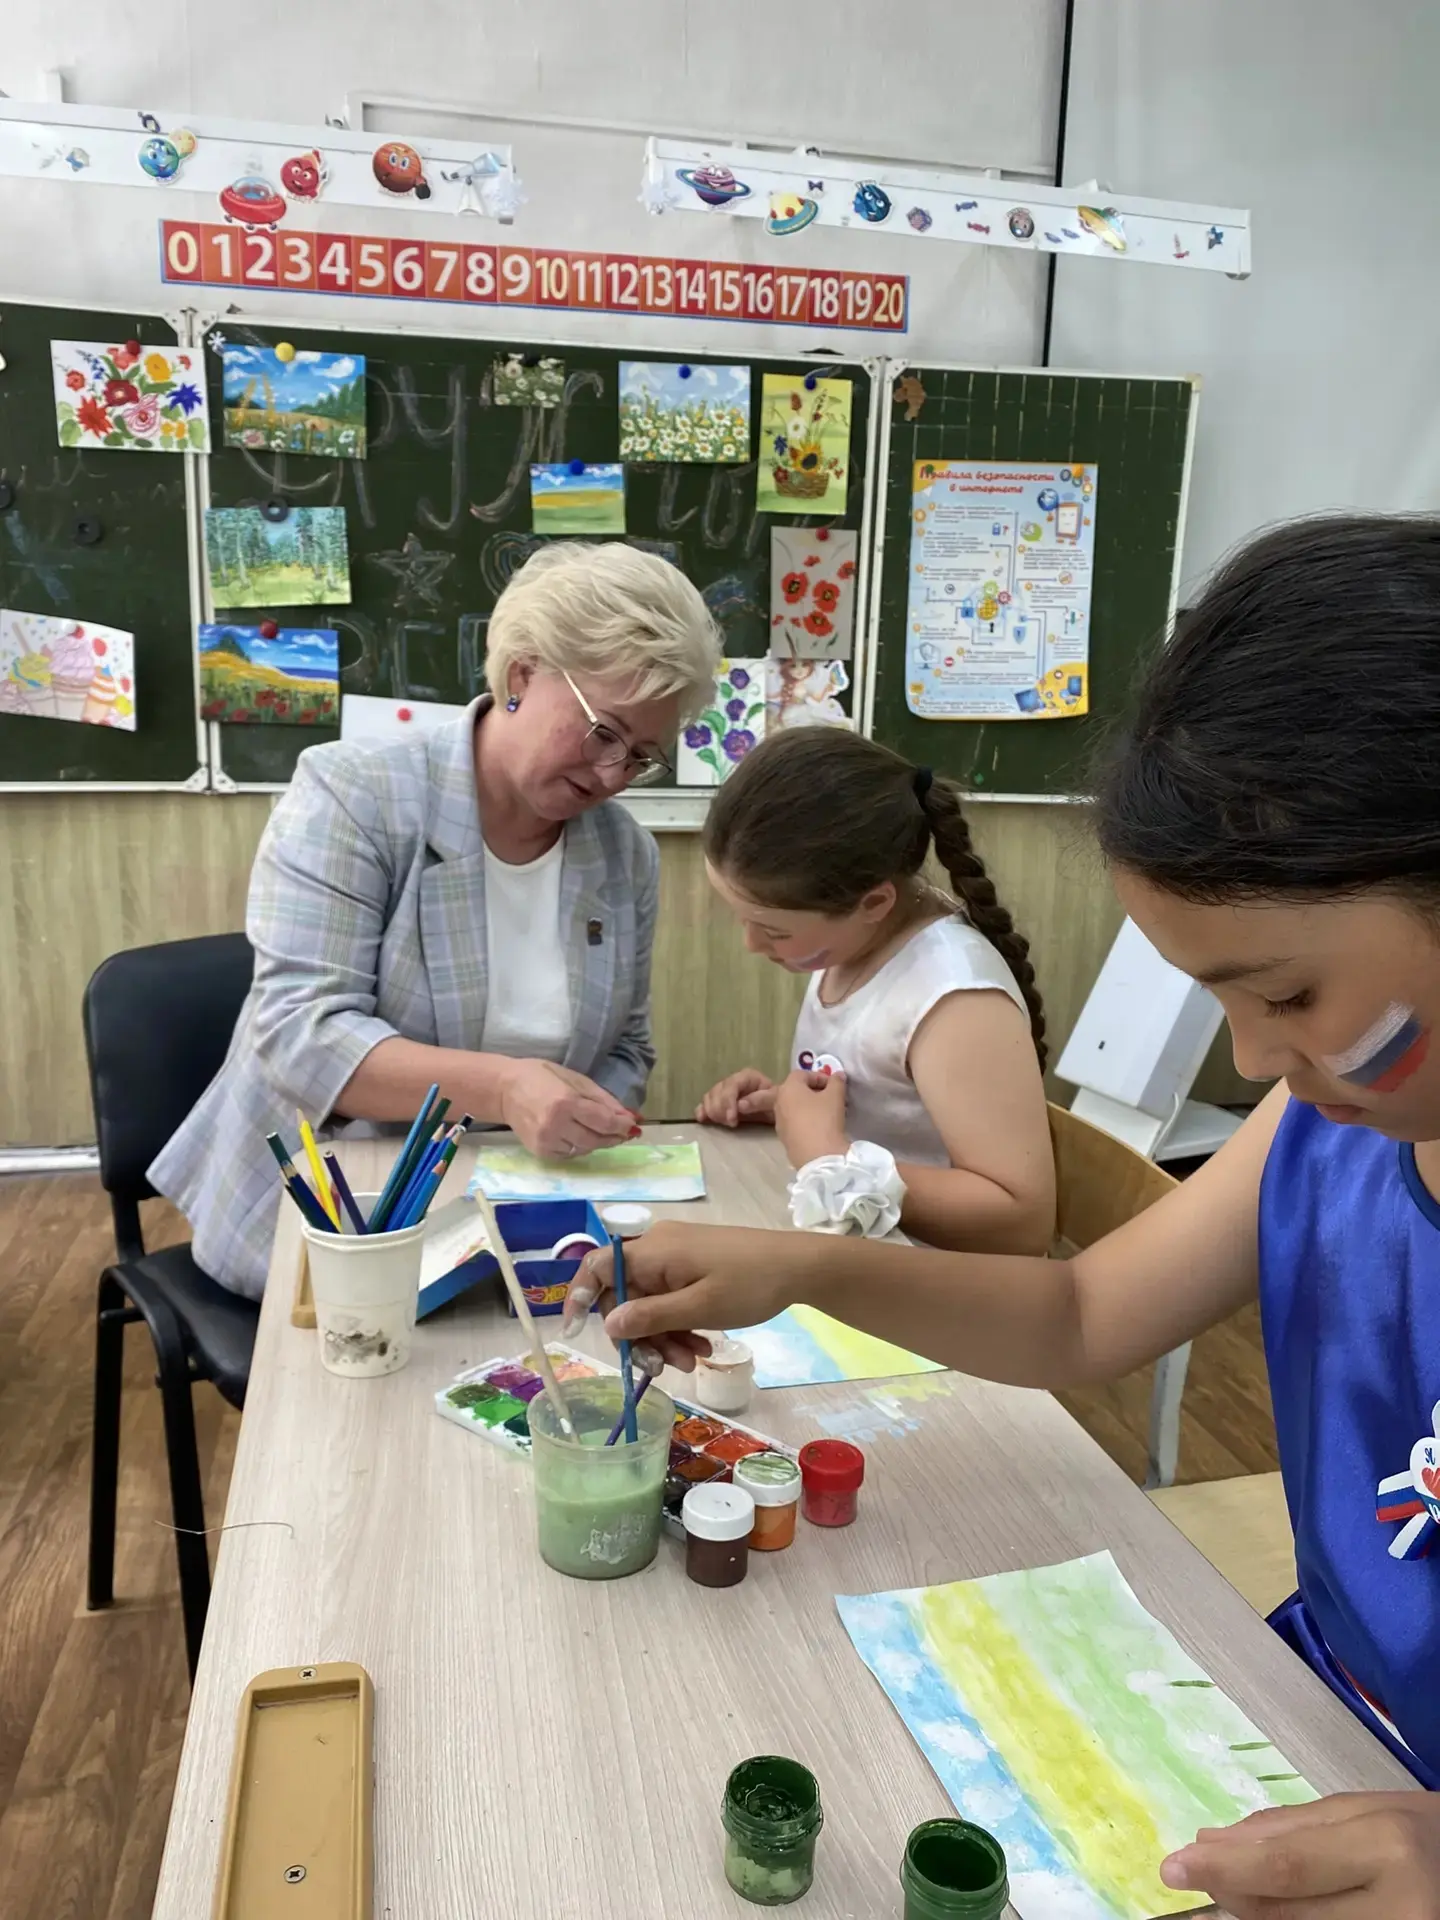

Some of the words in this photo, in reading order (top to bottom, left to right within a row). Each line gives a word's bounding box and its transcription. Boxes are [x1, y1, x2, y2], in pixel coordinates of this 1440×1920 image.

[168, 230, 198, 275] 0
[212, 233, 232, 277] 1
[245, 235, 275, 281] 2
[284, 238, 312, 283] 3
[319, 241, 350, 286] 4
[358, 244, 386, 288] 5
[393, 247, 424, 291] 6
[430, 250, 459, 293] 7
[465, 252, 495, 296] 8
[502, 254, 531, 298] 9
[535, 257, 568, 300] 10
[572, 259, 601, 303] 11
[606, 262, 639, 305] 12
[640, 264, 672, 306] 13
[675, 267, 707, 311] 14
[709, 270, 741, 312] 15
[742, 272, 774, 314] 16
[776, 275, 808, 317] 17
[809, 277, 840, 318] 18
[842, 279, 873, 321] 19
[874, 282, 904, 324] 20
